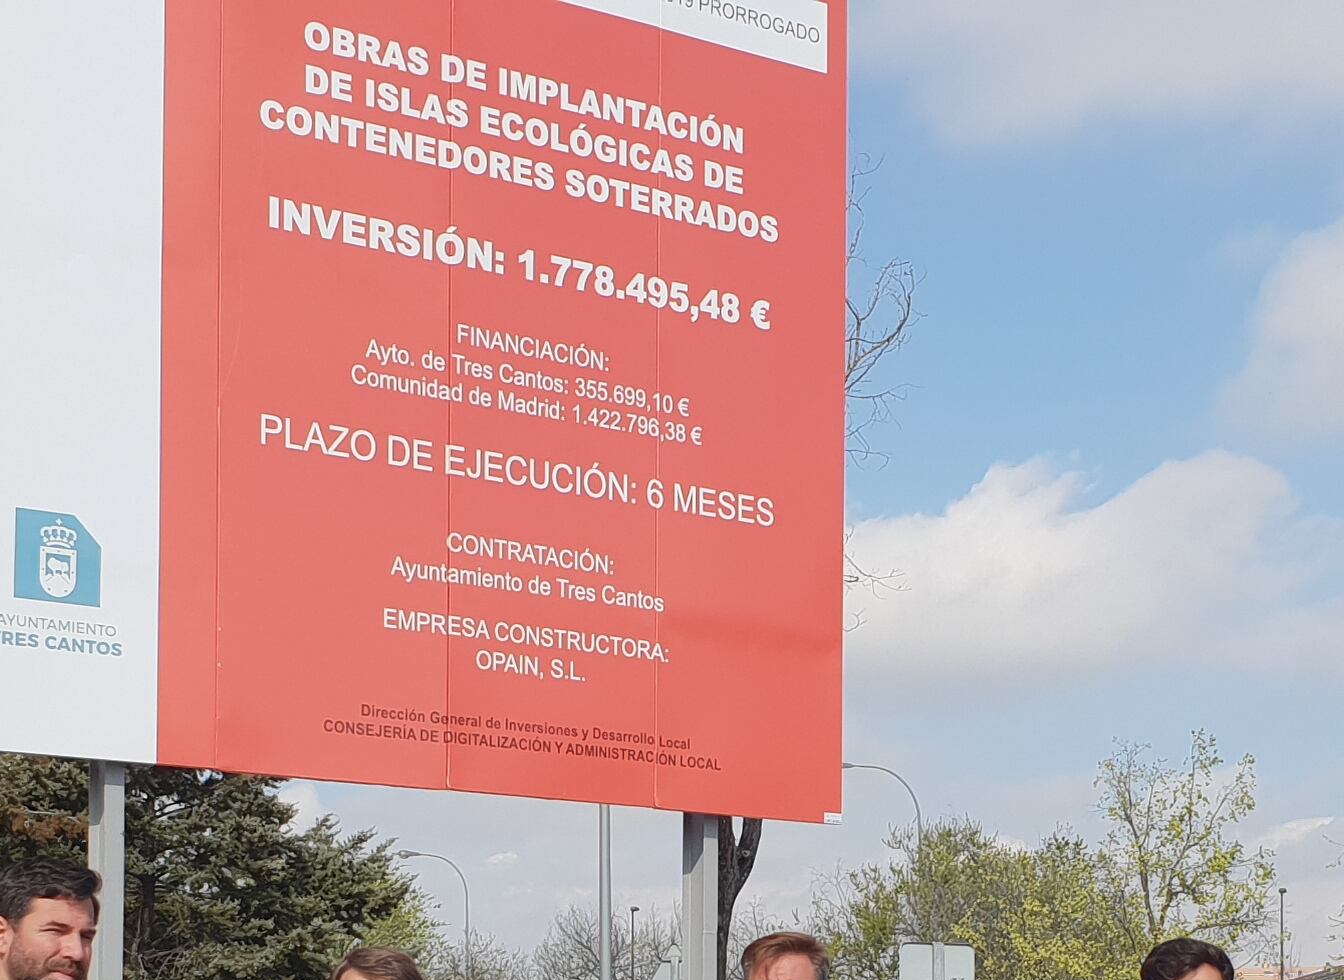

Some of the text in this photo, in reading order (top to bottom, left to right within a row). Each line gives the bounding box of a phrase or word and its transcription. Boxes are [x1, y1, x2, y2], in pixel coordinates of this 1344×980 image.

[699, 0, 820, 44] PRORROGADO
[304, 21, 744, 154] OBRAS DE IMPLANTACIÓN
[305, 64, 744, 195] DE ISLAS ECOLÓGICAS DE
[259, 99, 779, 243] CONTENEDORES SOTERRADOS
[268, 195, 771, 330] INVERSIÓN: 1.778.495,48 €
[457, 323, 609, 372] FINANCIACIÓN:
[351, 364, 703, 446] Comunidad de Madrid: 1.422.796,38 €
[365, 339, 690, 417] Ayto. de Tres Cantos: 355.699,10 €
[260, 413, 774, 527] PLAZO DE EJECUCIÓN: 6 MESES
[446, 532, 614, 575] CONTRATACIÓN:
[390, 556, 664, 612] Ayuntamiento de Tres Cantos
[44, 635, 122, 657] CANTOS
[383, 607, 669, 663] EMPRESA CONSTRUCTORA:
[475, 649, 586, 682] OPAIN, S.L.
[323, 719, 722, 771] CONSEJERÍA DE DIGITALIZACIÓN Y ADMINISTRACIÓN LOCAL
[361, 703, 691, 750] Dirección General de Inversiones y Desarrollo Local
